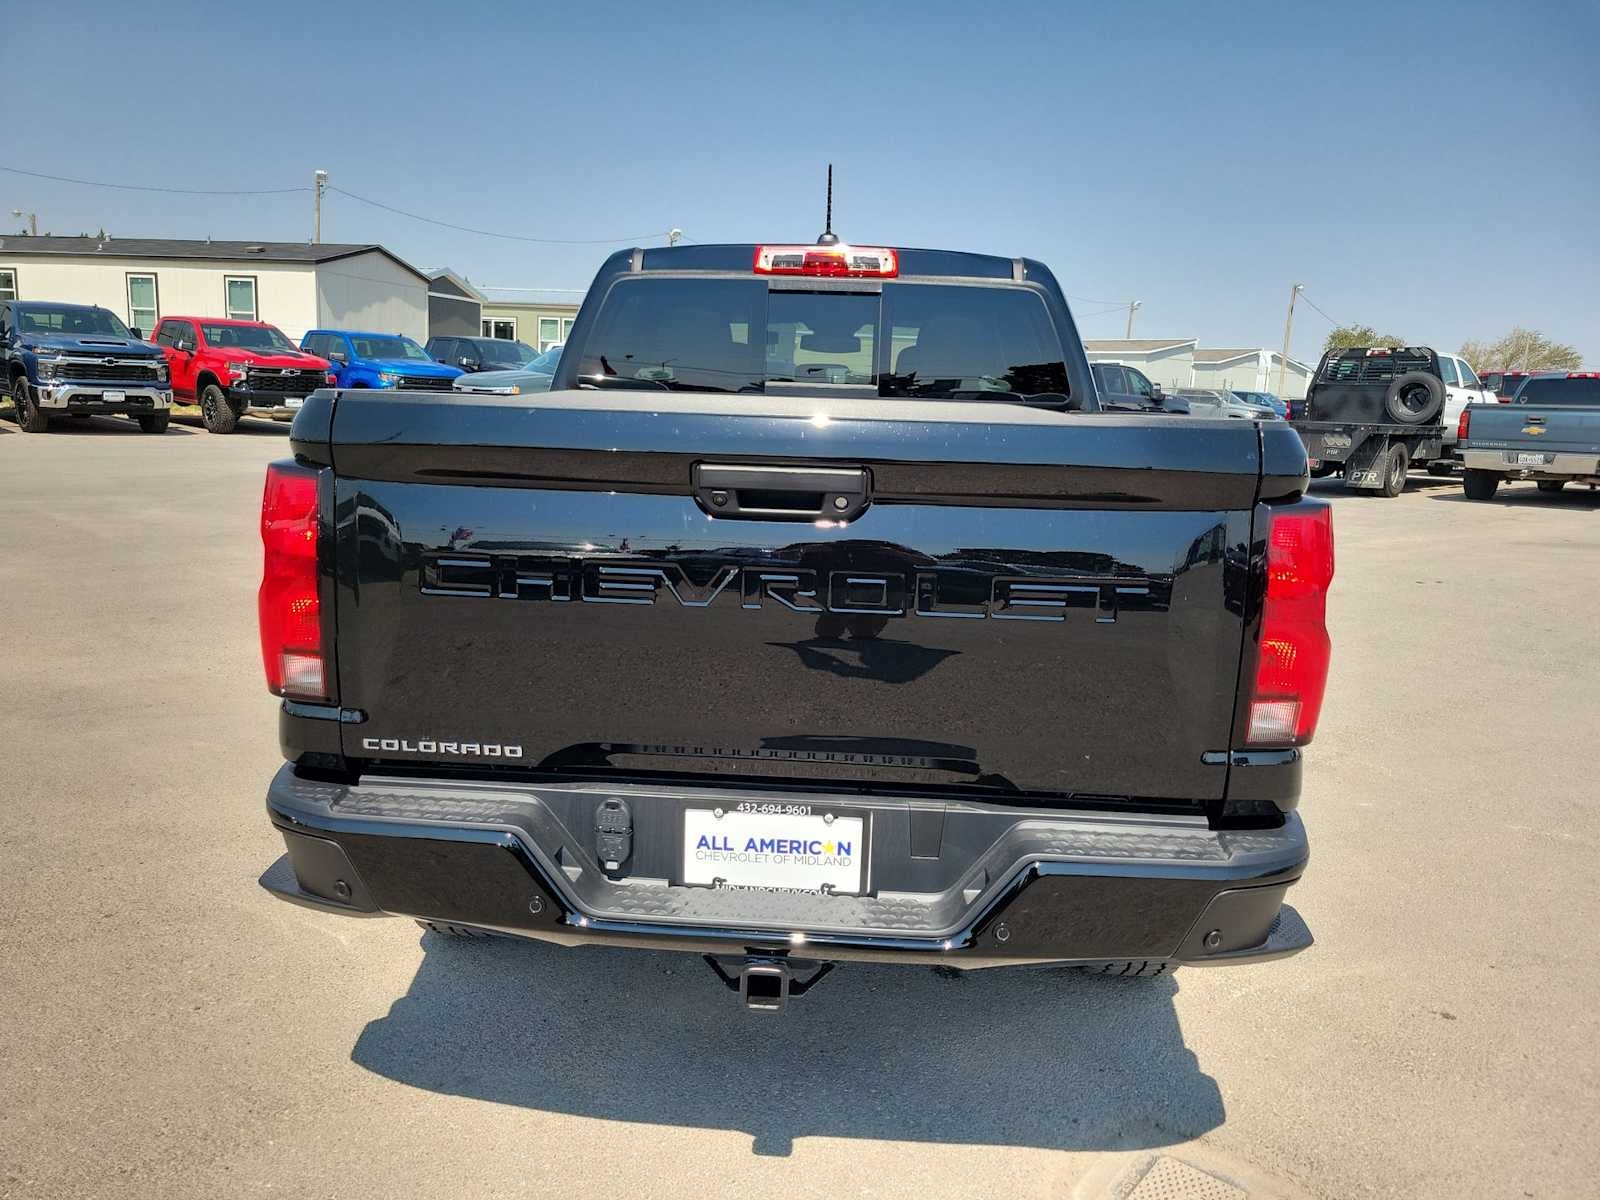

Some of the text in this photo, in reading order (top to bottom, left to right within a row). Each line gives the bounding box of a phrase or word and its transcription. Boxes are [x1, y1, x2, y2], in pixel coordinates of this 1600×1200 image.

[1351, 471, 1377, 481] PTR
[420, 554, 1170, 623] CHEVROLET
[362, 738, 523, 758] COLORADO
[737, 803, 812, 816] 432-694-9601
[697, 835, 734, 851] ALL
[695, 850, 852, 867] CHEVROLET OF MIDLAND
